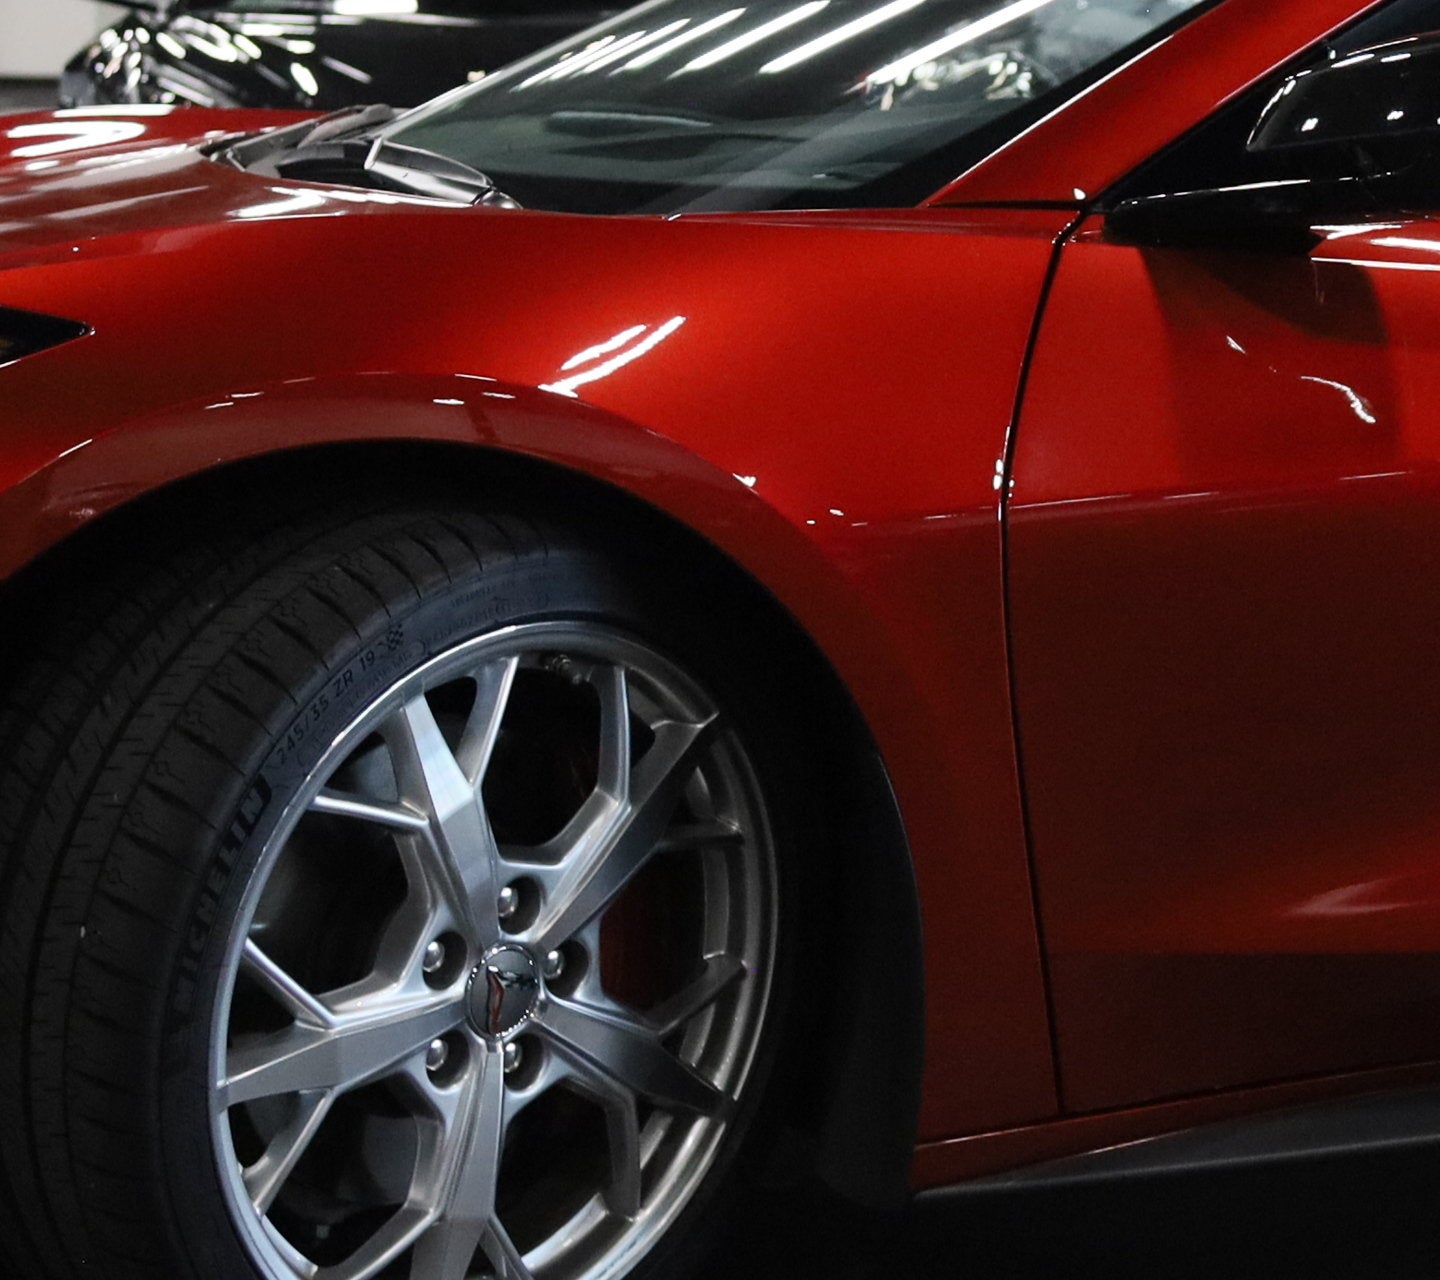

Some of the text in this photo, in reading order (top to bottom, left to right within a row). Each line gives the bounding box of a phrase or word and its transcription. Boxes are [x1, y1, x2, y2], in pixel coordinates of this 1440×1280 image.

[276, 695, 330, 765] 245/35
[333, 669, 354, 698] ZR
[359, 649, 376, 672] 19
[172, 786, 264, 1015] MICHELIN
